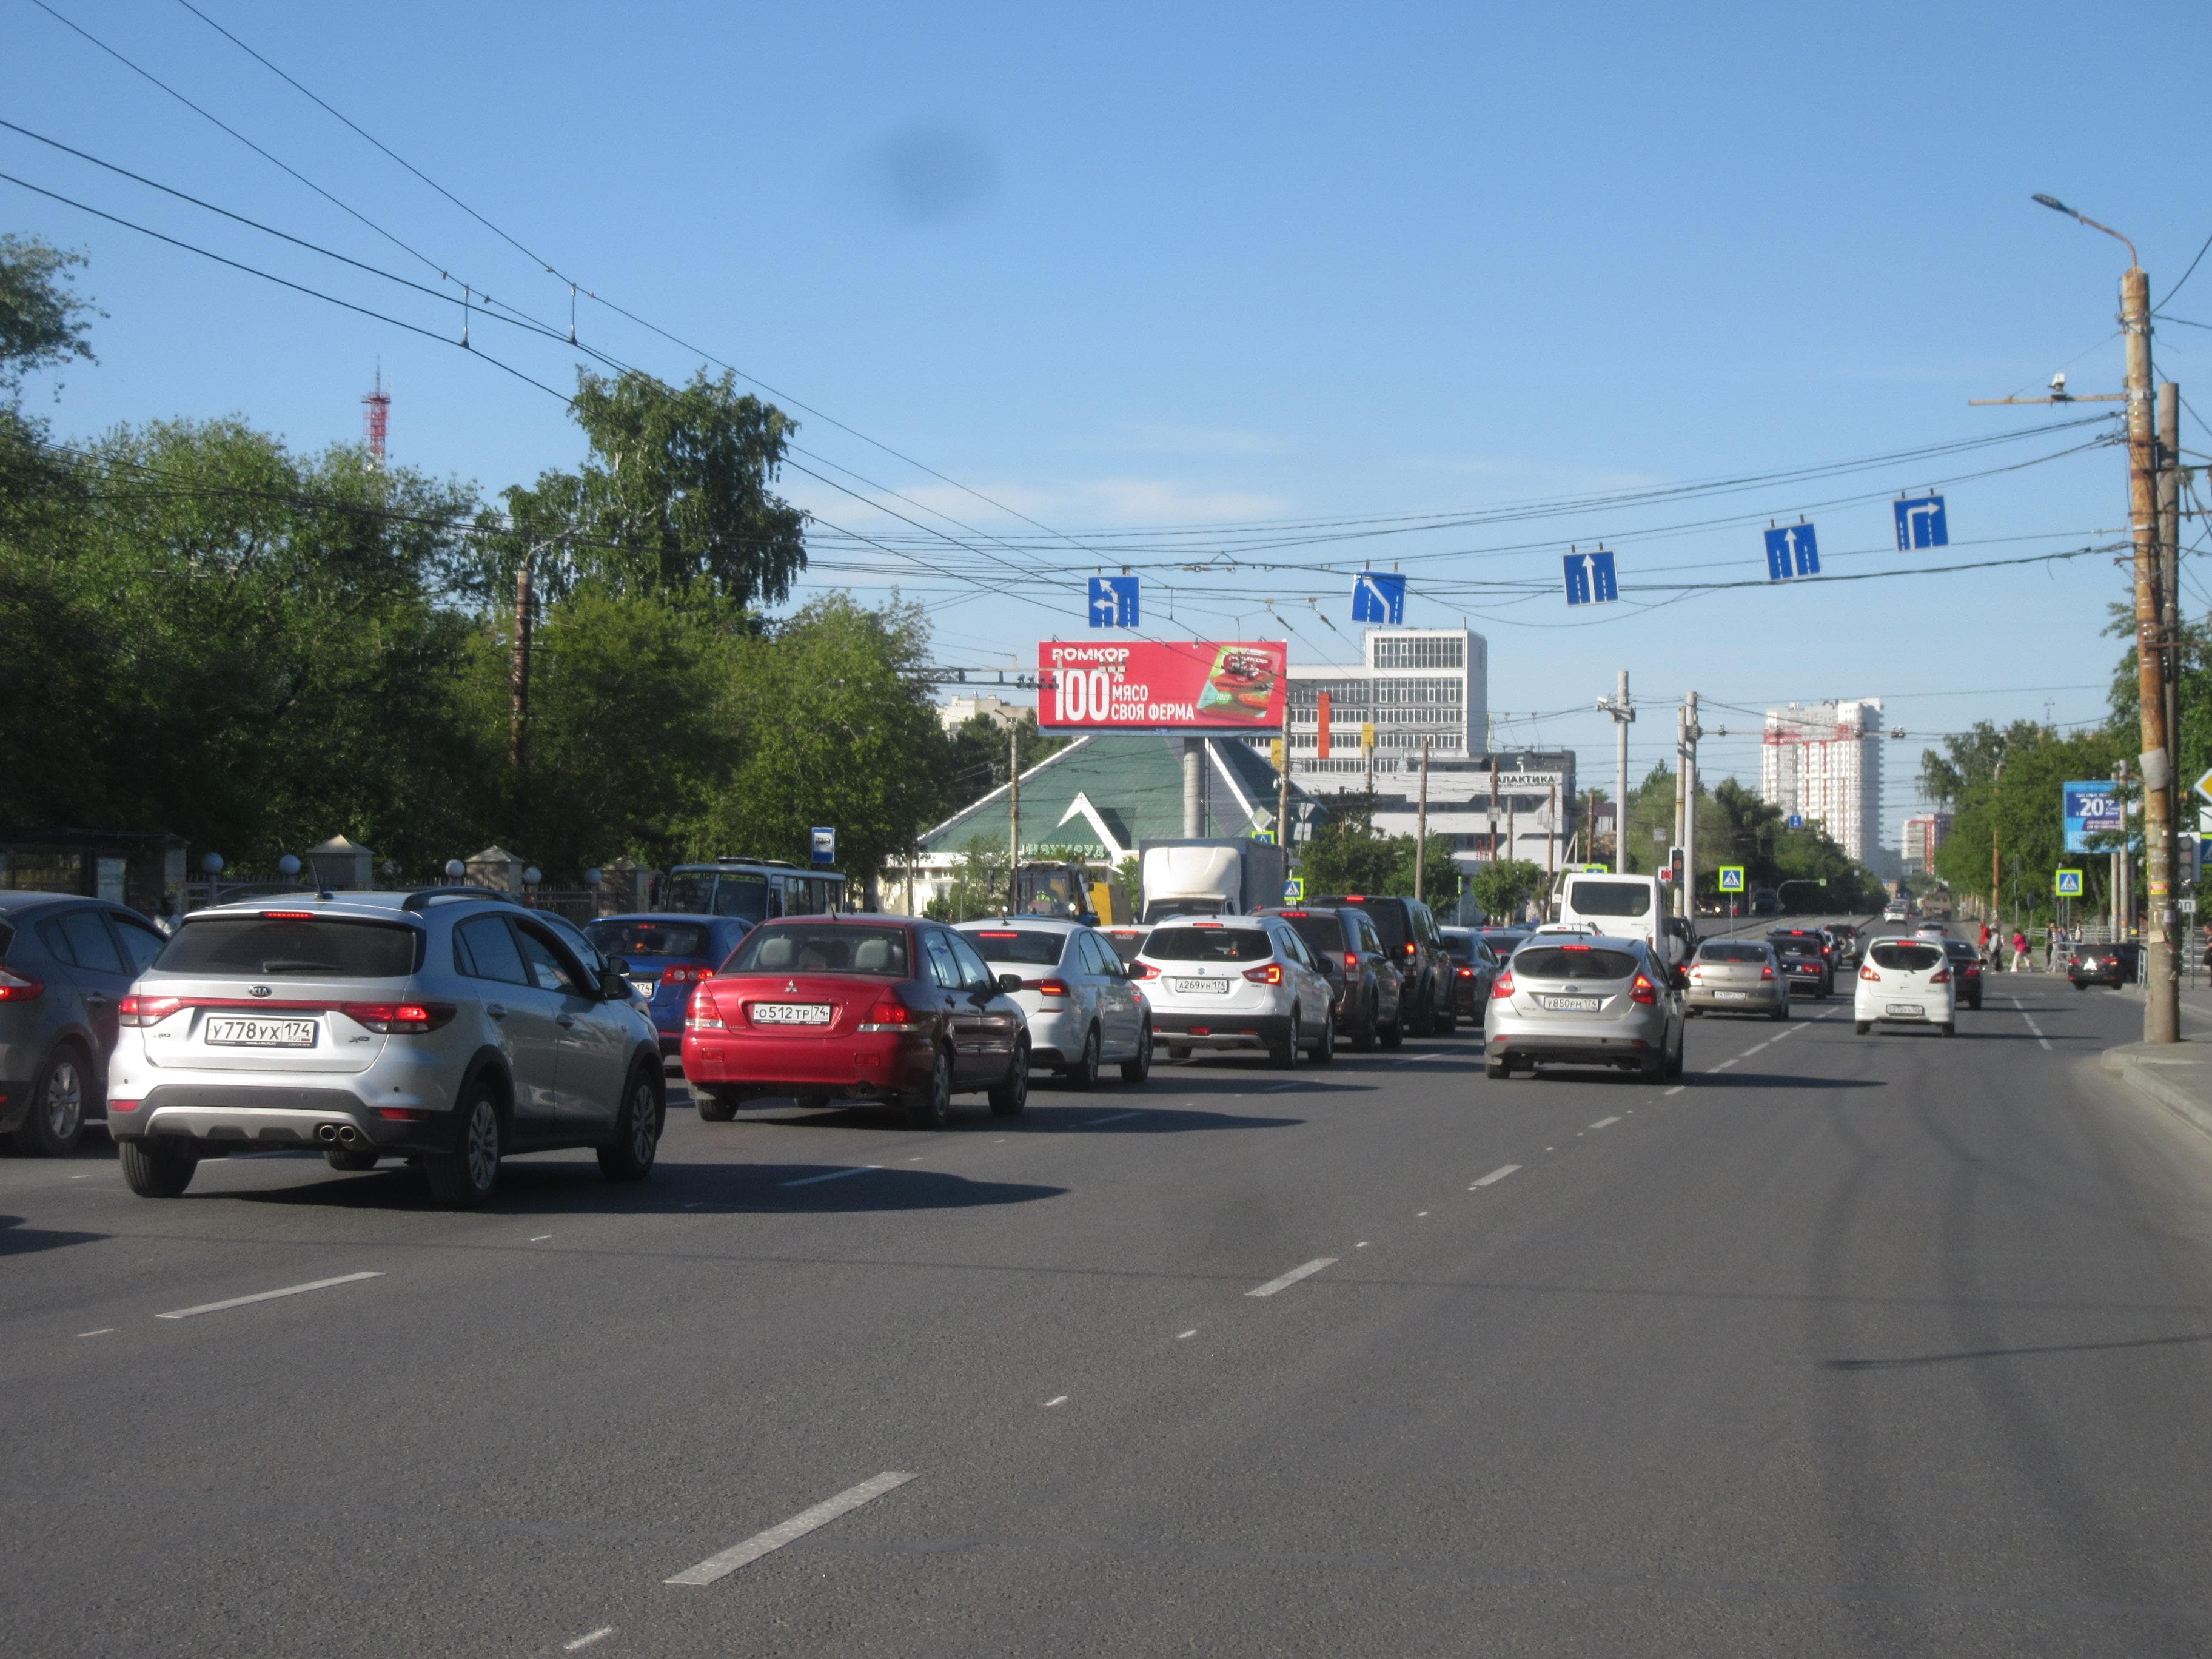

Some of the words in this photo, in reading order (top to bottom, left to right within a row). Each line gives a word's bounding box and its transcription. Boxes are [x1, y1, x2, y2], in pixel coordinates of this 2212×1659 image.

[1052, 648, 1130, 661] РОМКОР
[1052, 670, 1110, 721] 100
[1111, 685, 1148, 702] МЯСО
[1111, 703, 1145, 720] СВОЯ
[1148, 703, 1195, 720] ФЕРМА
[1179, 981, 1211, 990] А269УН
[1547, 999, 1581, 1008] У850РМ
[814, 1007, 826, 1016] 74
[213, 1022, 280, 1040] У778УХ
[284, 1022, 310, 1036] 174
